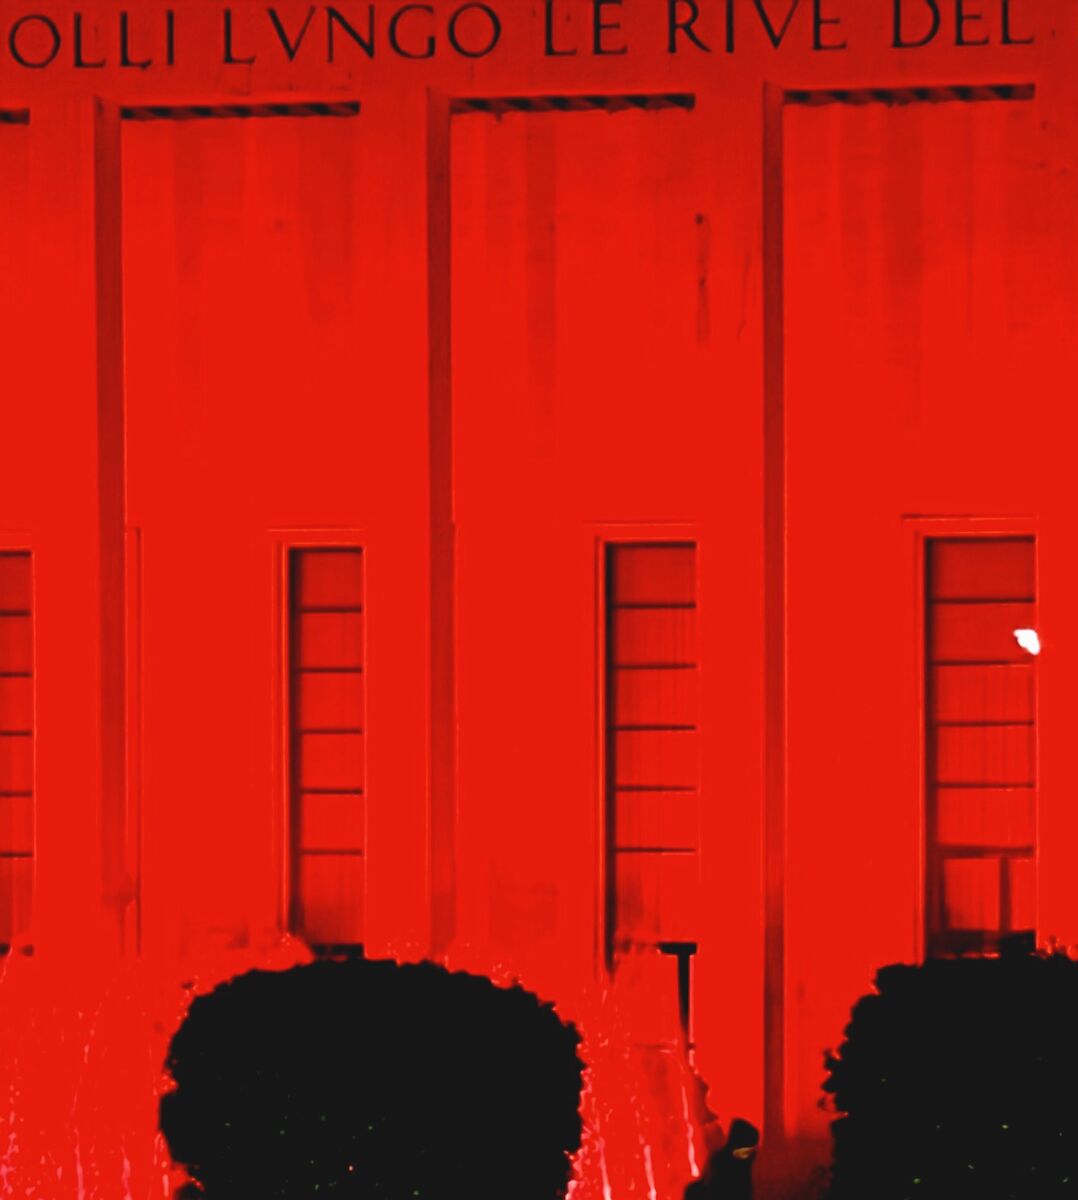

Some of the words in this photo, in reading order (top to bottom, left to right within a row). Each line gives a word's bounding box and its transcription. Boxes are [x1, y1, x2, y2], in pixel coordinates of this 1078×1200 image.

[8, 10, 176, 71] OLLI
[223, 2, 503, 65] LVNGO
[543, 0, 628, 58] LE
[667, 0, 848, 56] RIVE
[891, 0, 1035, 50] DEL
